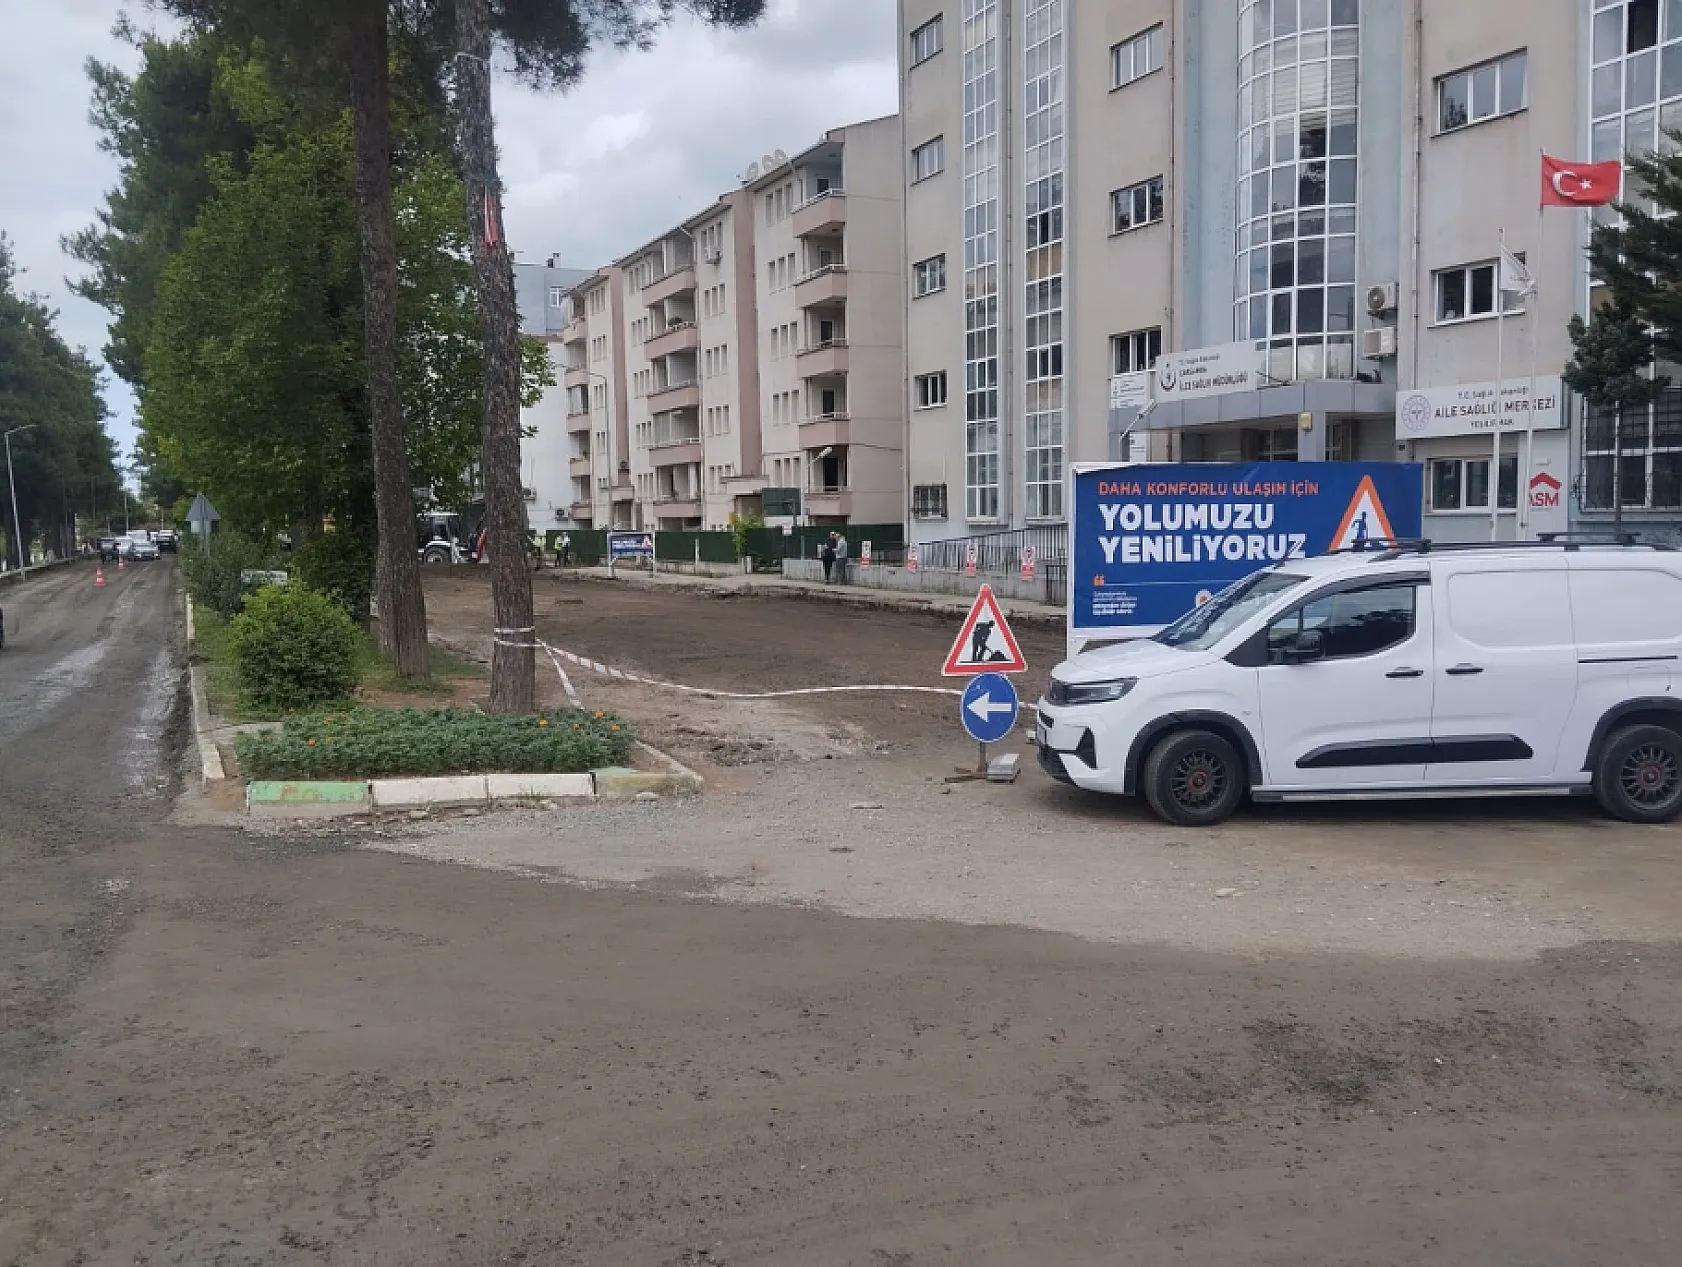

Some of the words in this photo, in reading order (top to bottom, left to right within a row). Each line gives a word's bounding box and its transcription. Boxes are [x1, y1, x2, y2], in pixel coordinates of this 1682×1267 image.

[1434, 404, 1458, 418] AİLE
[1098, 481, 1141, 495] DAHA
[1146, 481, 1228, 495] KONFORLU
[1232, 481, 1286, 498] ULAŞIM
[1291, 480, 1319, 497] İÇİN
[1098, 503, 1274, 530] YOLUMUZU
[1098, 533, 1306, 564] YENİLİYORUZ
